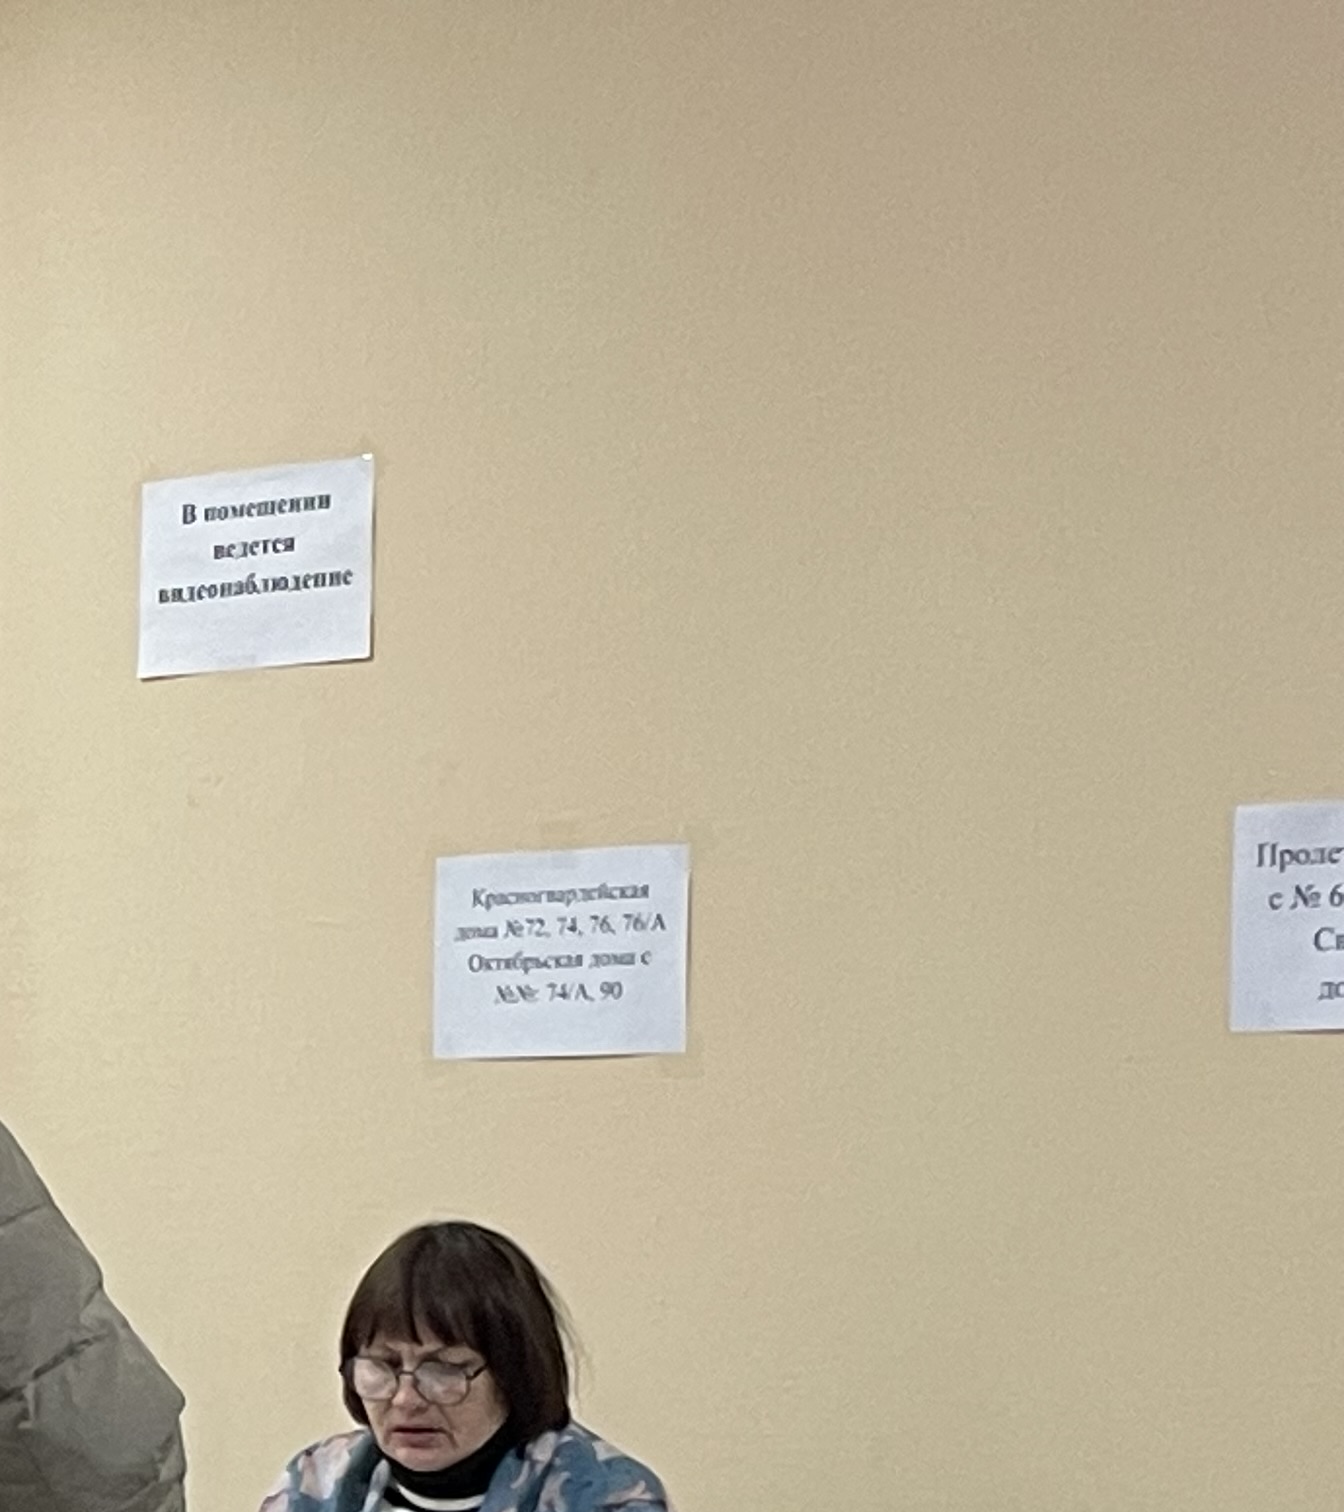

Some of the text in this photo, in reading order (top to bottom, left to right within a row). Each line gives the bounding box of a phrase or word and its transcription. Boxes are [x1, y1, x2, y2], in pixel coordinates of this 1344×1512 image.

[182, 493, 331, 525] В помещении
[213, 536, 295, 560] ведется
[158, 569, 354, 604] видеонаблюдение
[1257, 841, 1344, 873] Проле
[472, 883, 649, 911] Красногвардейская
[1269, 892, 1283, 910] с
[454, 926, 498, 942] дома
[468, 950, 652, 974] Октябрьская дома с
[599, 981, 624, 1000] 90
